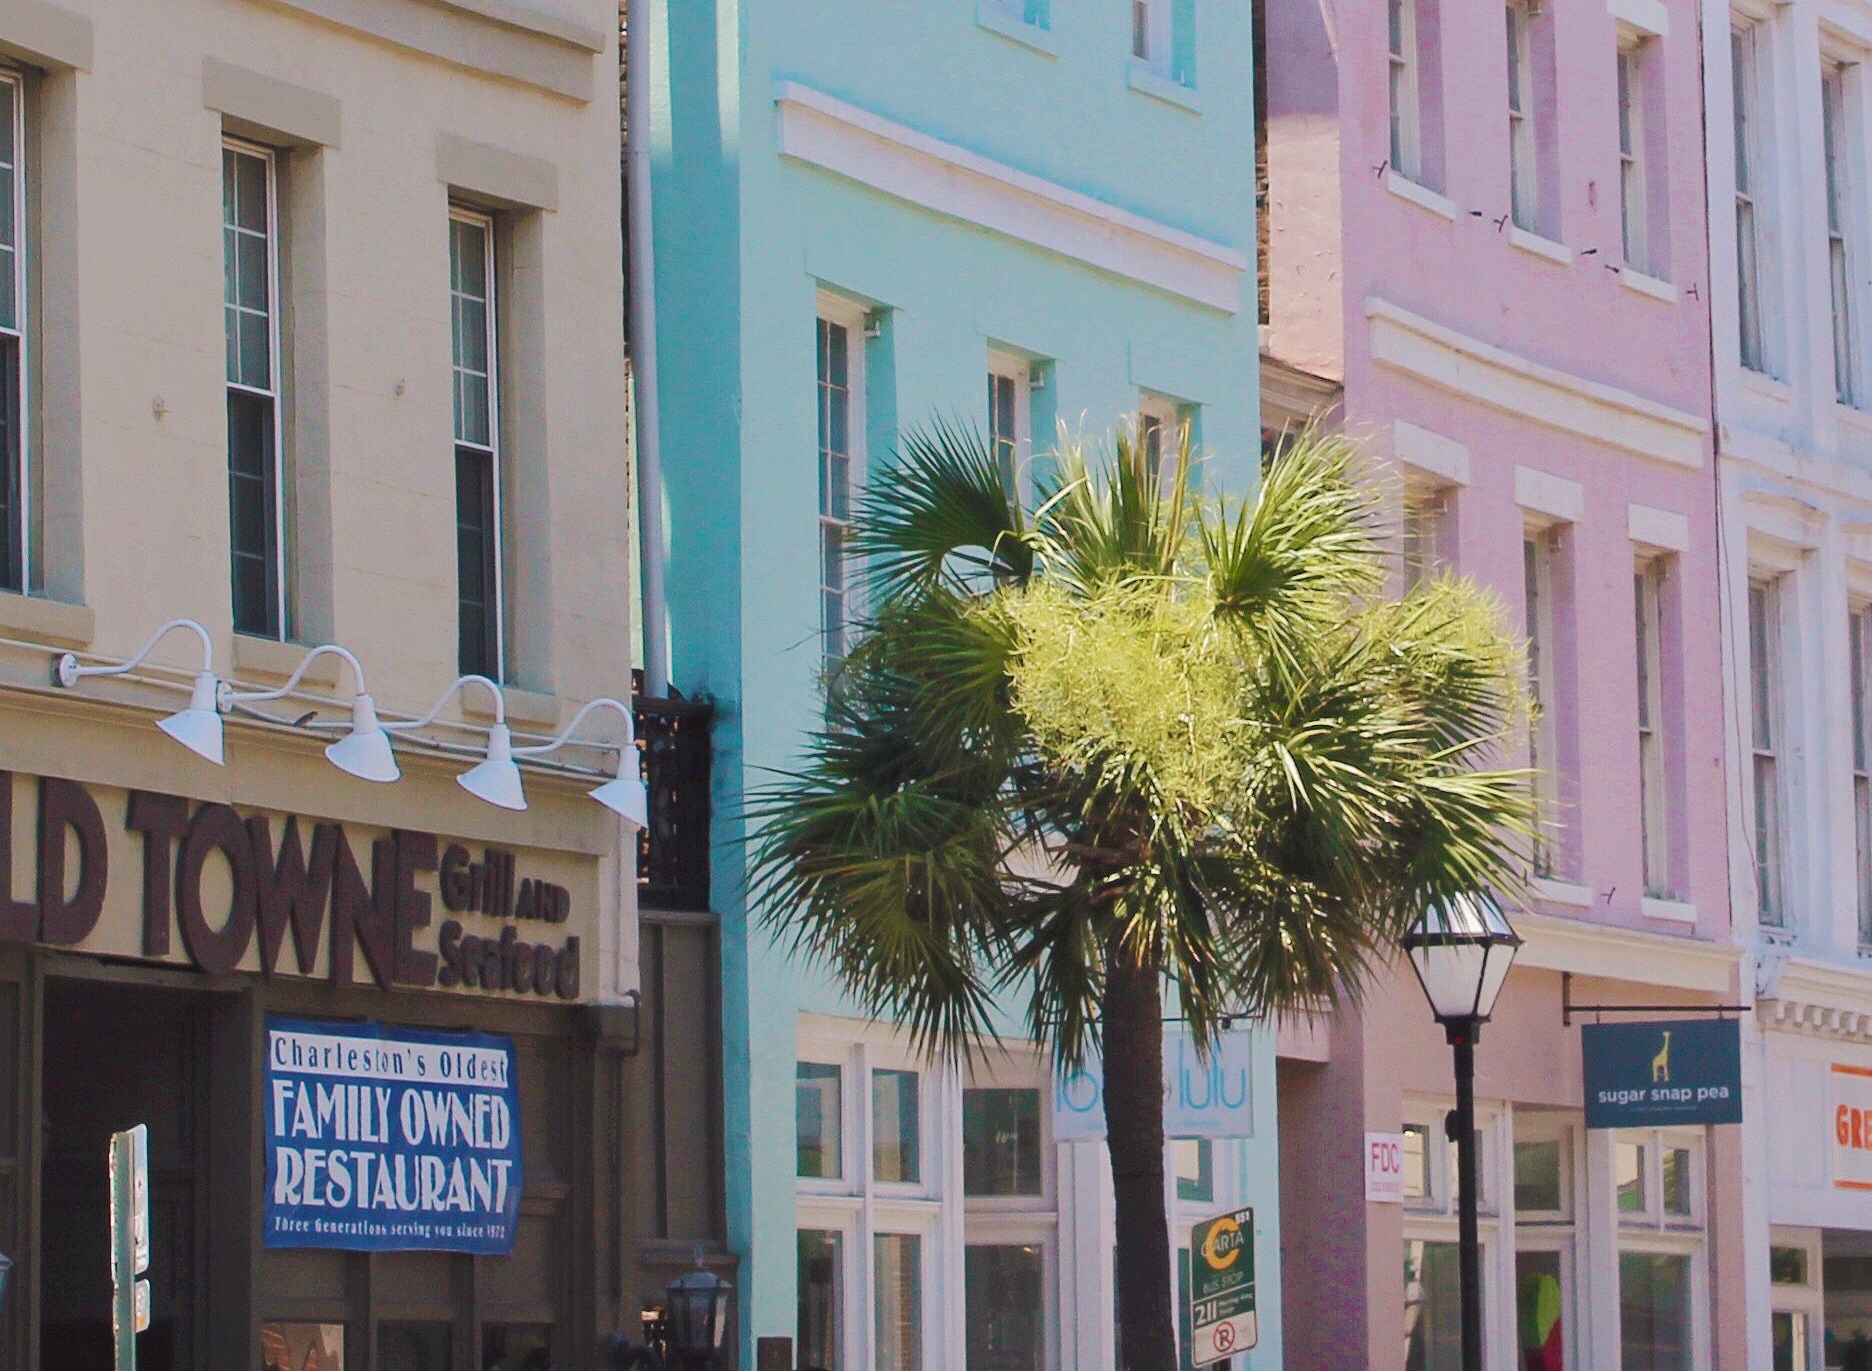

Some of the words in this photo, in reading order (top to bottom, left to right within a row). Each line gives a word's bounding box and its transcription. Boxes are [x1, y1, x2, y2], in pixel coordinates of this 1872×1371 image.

[124, 787, 438, 991] TOWNE
[439, 843, 516, 918] Grill
[515, 877, 571, 923] AND
[438, 920, 581, 1000] Seafood
[274, 1036, 426, 1077] Charleston's
[439, 1050, 508, 1083] Oldest
[272, 1078, 392, 1144] FAMILY
[400, 1088, 510, 1150] OWNED
[1598, 1088, 1646, 1105] sugar
[1651, 1088, 1692, 1102] snap
[1697, 1085, 1729, 1101] pea
[274, 1146, 513, 1214] RESTAURANT
[1371, 1141, 1400, 1174] FDC
[274, 1215, 310, 1233] Three
[314, 1217, 387, 1236] Generations
[391, 1222, 430, 1239] serving
[457, 1222, 484, 1238] since
[1194, 1300, 1218, 1327] 211
